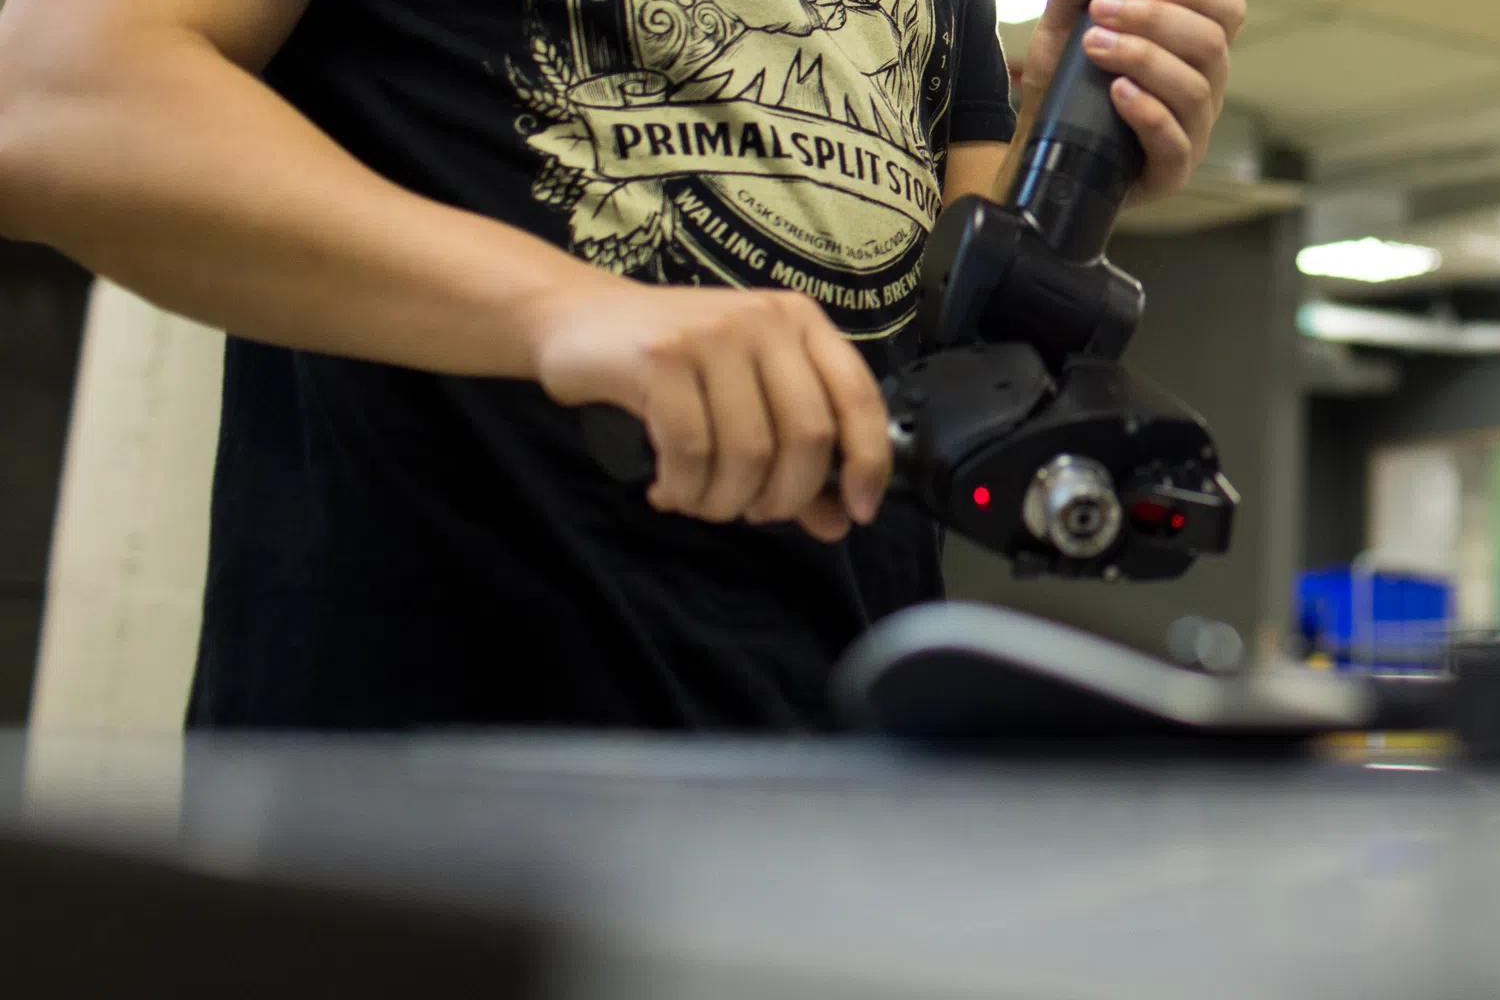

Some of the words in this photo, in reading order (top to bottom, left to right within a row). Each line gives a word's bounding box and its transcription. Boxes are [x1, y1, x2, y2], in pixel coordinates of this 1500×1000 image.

[612, 122, 793, 160] PRIMAL
[790, 132, 880, 185] SPLIT
[676, 187, 769, 270] WAILING
[771, 260, 882, 310] MOUNTAINS
[737, 189, 772, 221] CASK
[773, 215, 843, 254] STRENGTH
